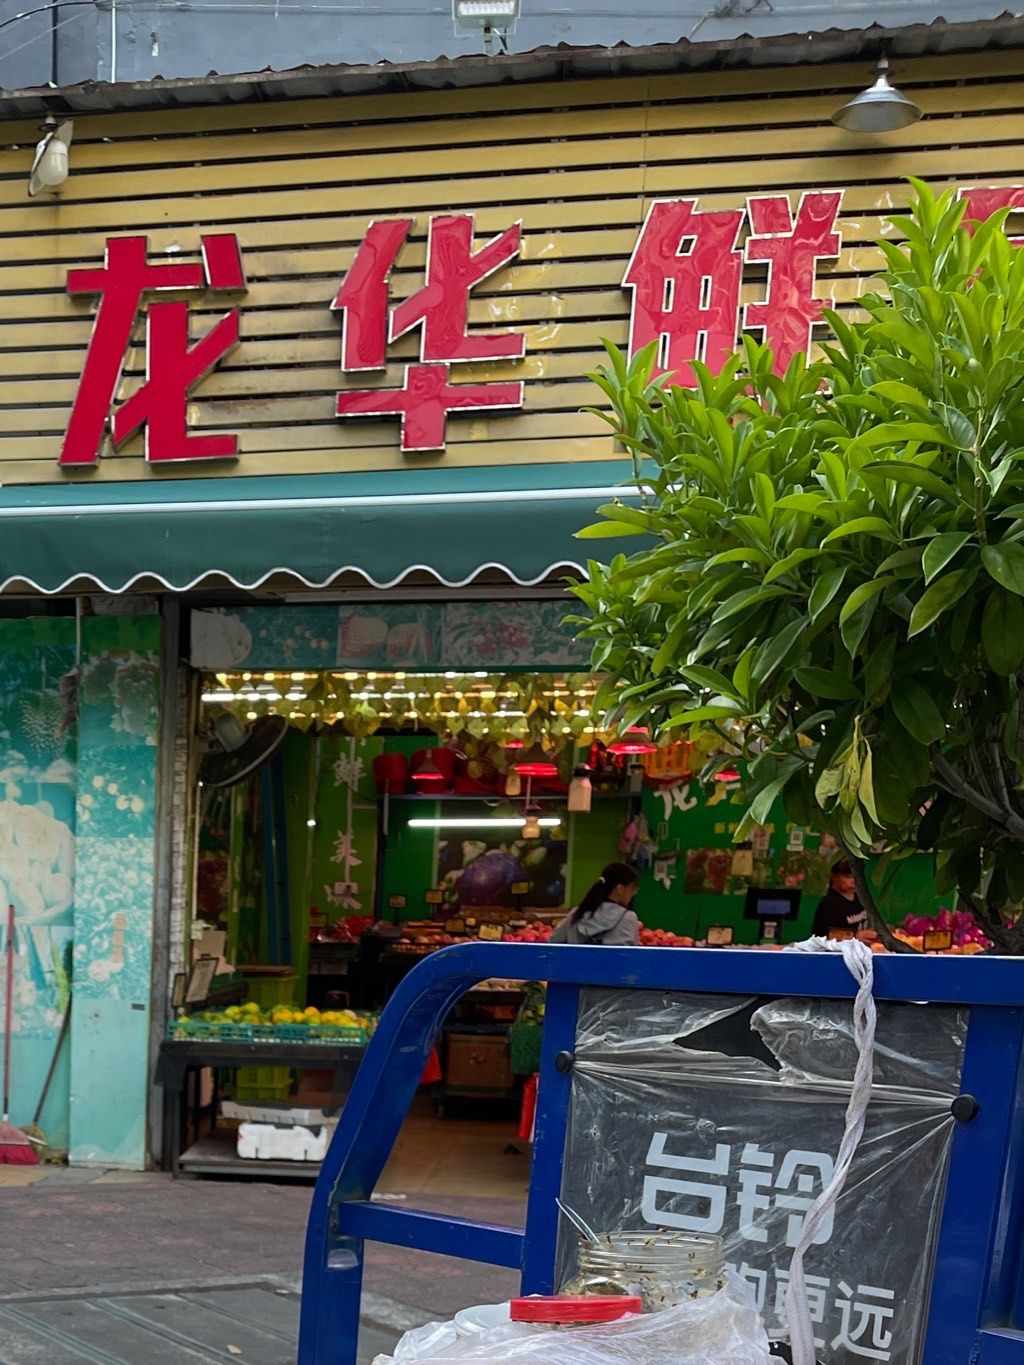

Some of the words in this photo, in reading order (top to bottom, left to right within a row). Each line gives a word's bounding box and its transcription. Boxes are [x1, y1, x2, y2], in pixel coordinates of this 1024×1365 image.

[58, 188, 1024, 468] 龙华鲜
[641, 1132, 836, 1248] 台铃
